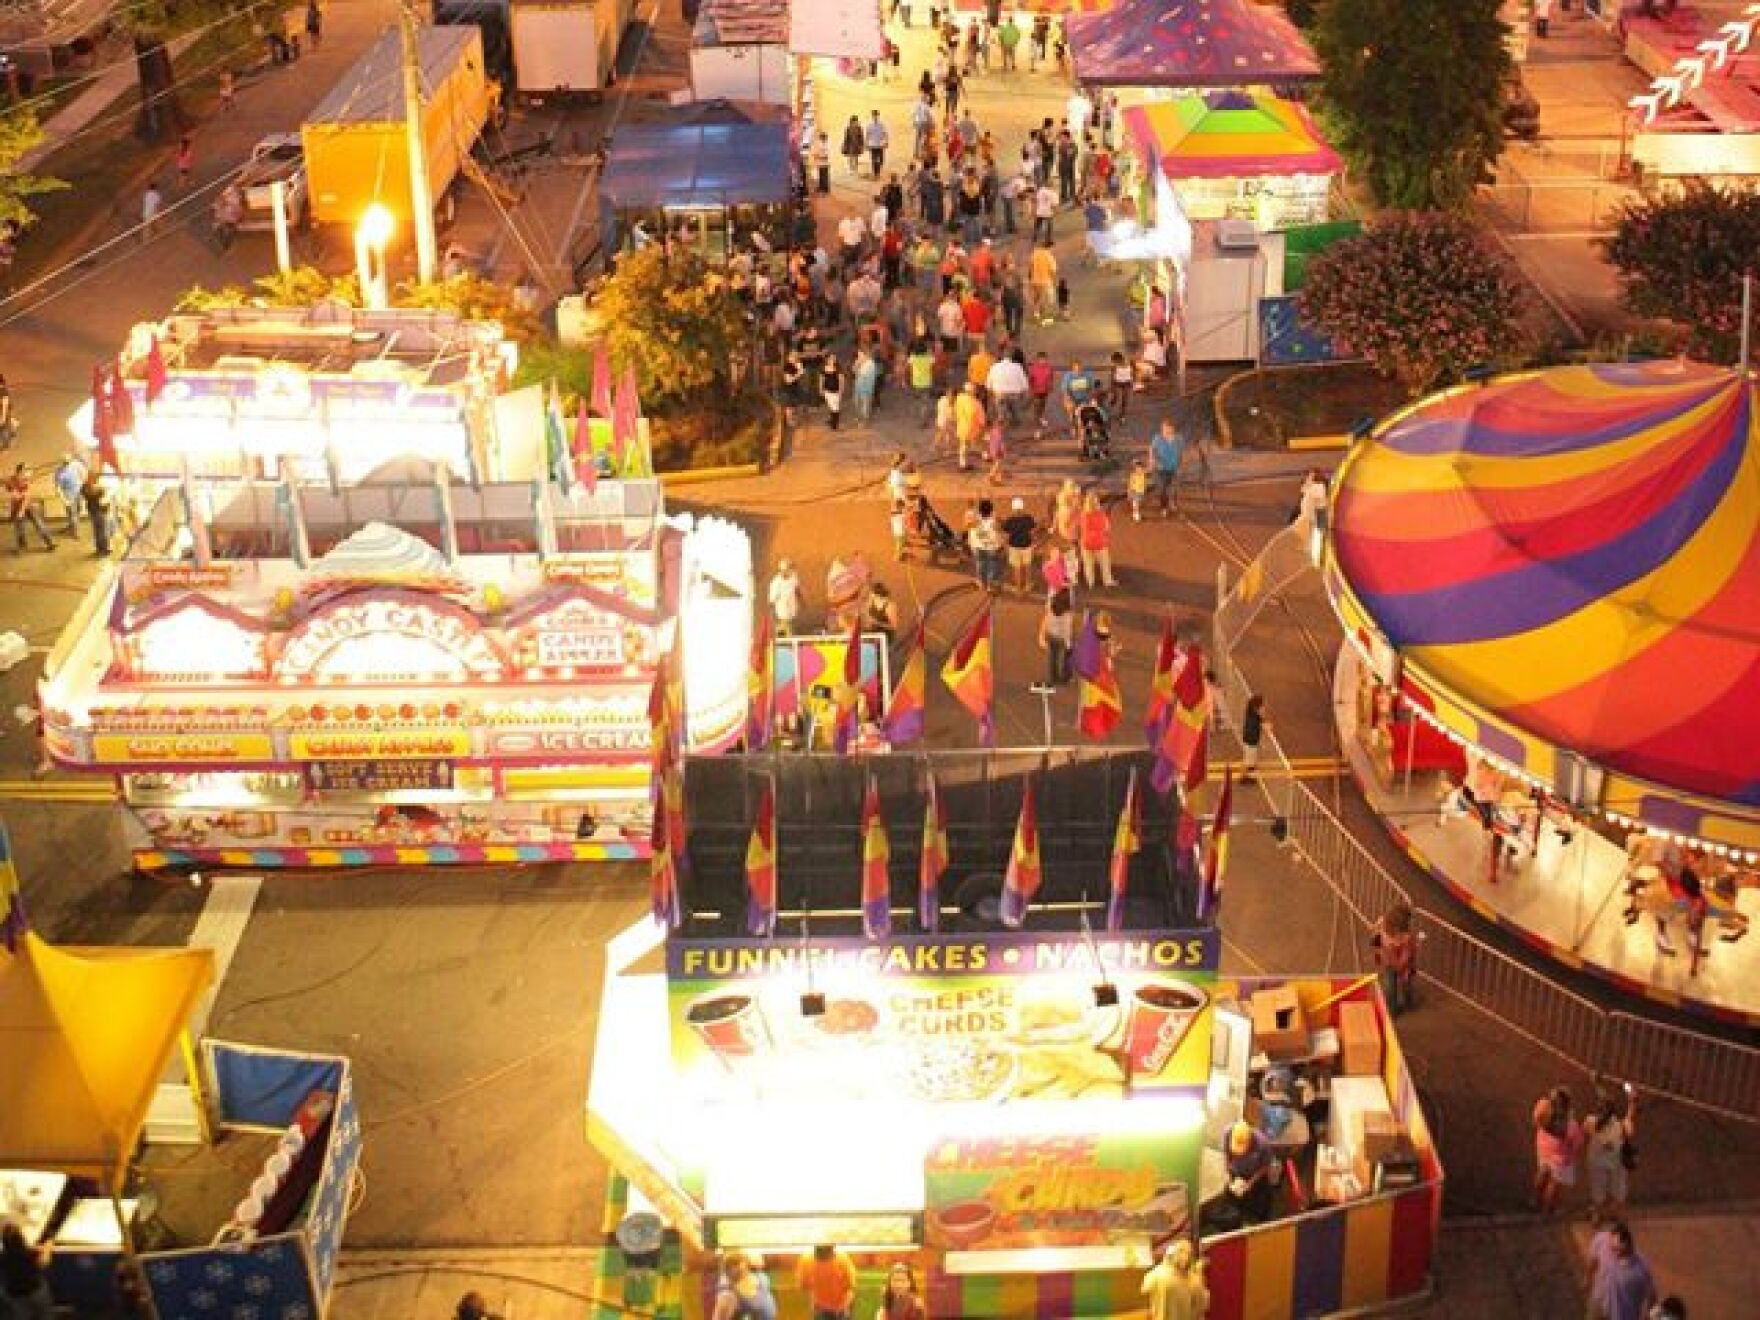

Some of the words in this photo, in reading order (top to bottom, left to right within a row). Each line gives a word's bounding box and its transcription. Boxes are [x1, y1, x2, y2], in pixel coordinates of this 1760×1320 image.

[285, 606, 370, 670] CANDY
[383, 606, 500, 670] CASTLE
[326, 761, 367, 777] SOFT
[376, 761, 433, 777] SERVE
[366, 777, 430, 789] CREAM
[683, 947, 837, 974] FUNNEL
[857, 943, 988, 971] CAKES
[1036, 939, 1203, 969] NACHOS
[888, 985, 1013, 1014] CHEESE
[898, 1010, 1008, 1037] CURDS
